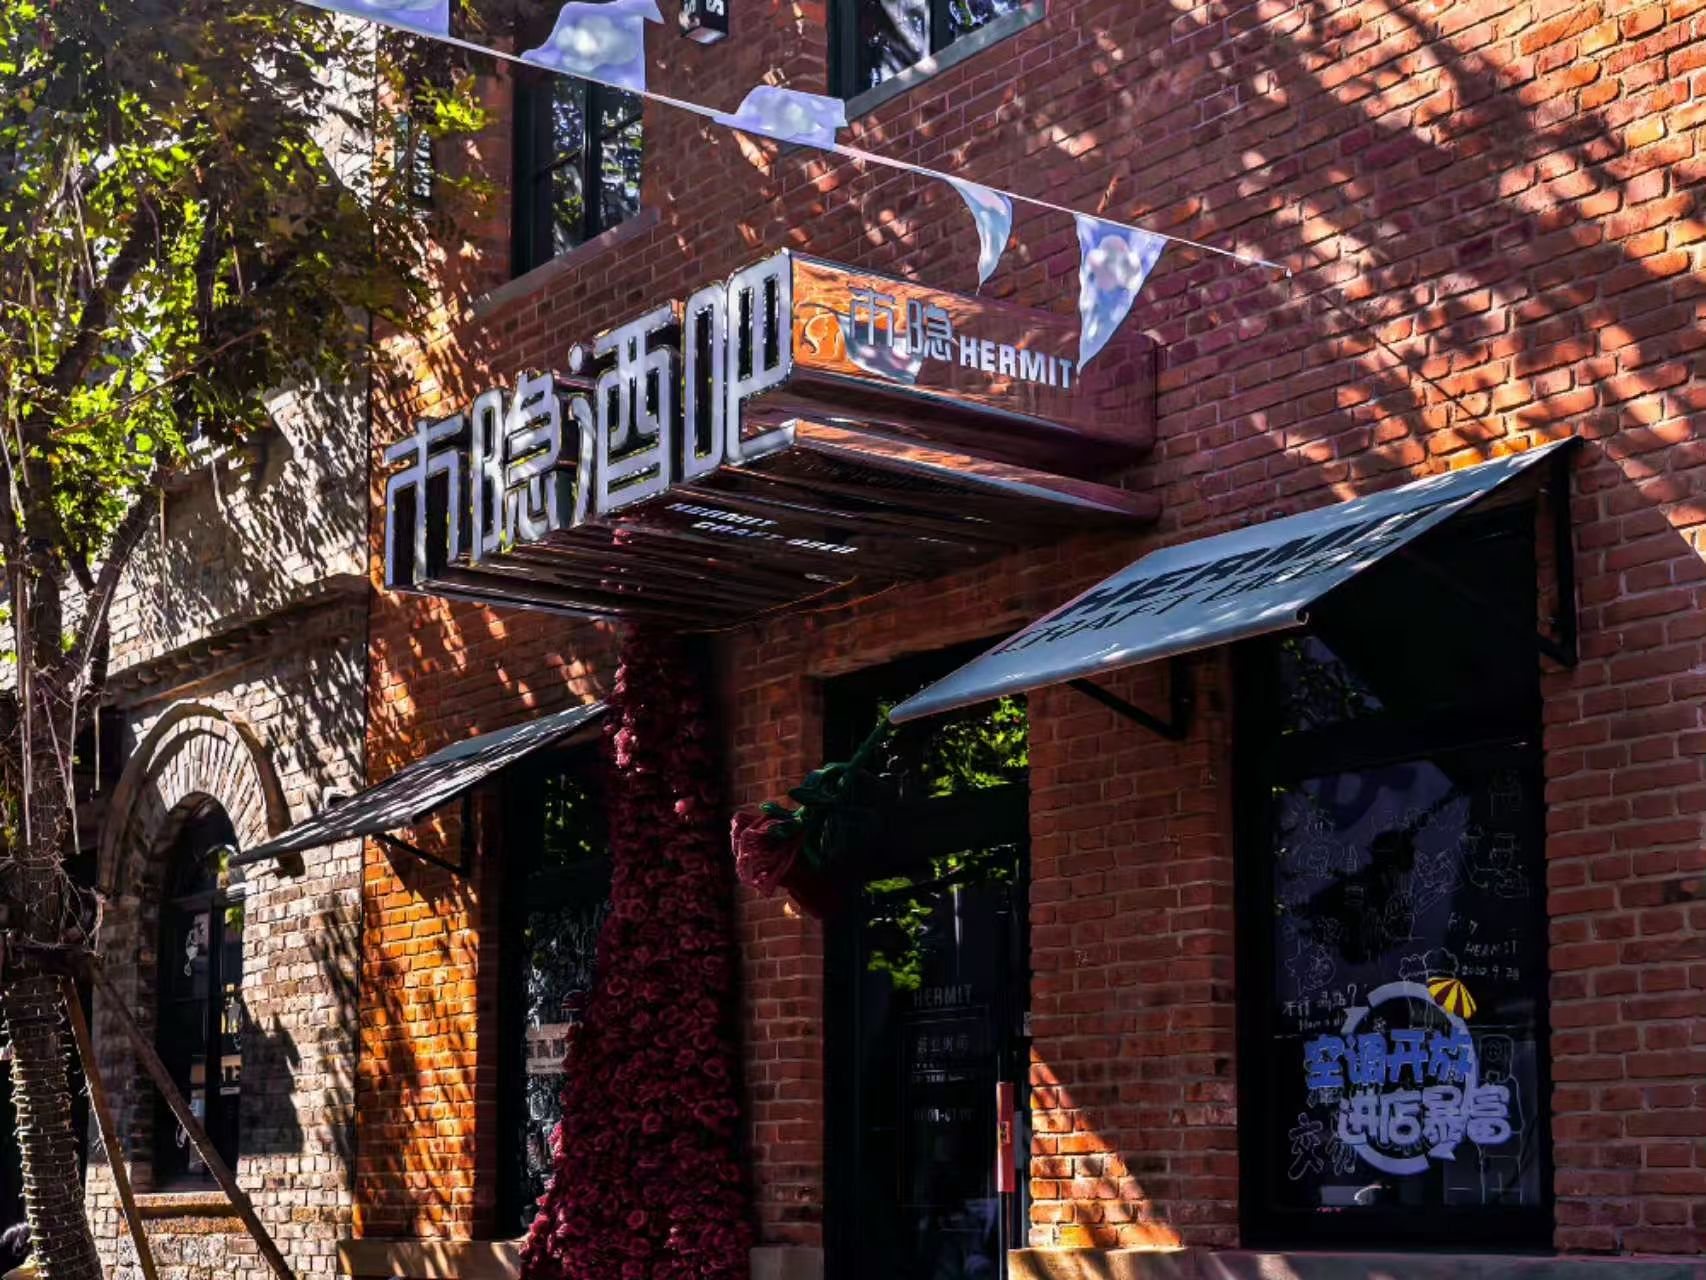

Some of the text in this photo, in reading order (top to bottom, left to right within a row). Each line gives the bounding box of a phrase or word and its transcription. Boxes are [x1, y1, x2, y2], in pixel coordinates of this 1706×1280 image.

[849, 286, 953, 361] 市隐
[960, 336, 1073, 388] HERMIT
[384, 248, 798, 589] 市隐酒吧
[1040, 488, 1478, 623] HERMIT
[989, 536, 1402, 657] CRAFT BEER
[913, 984, 973, 1008] HERMIT
[1303, 1026, 1472, 1089] 空调开放
